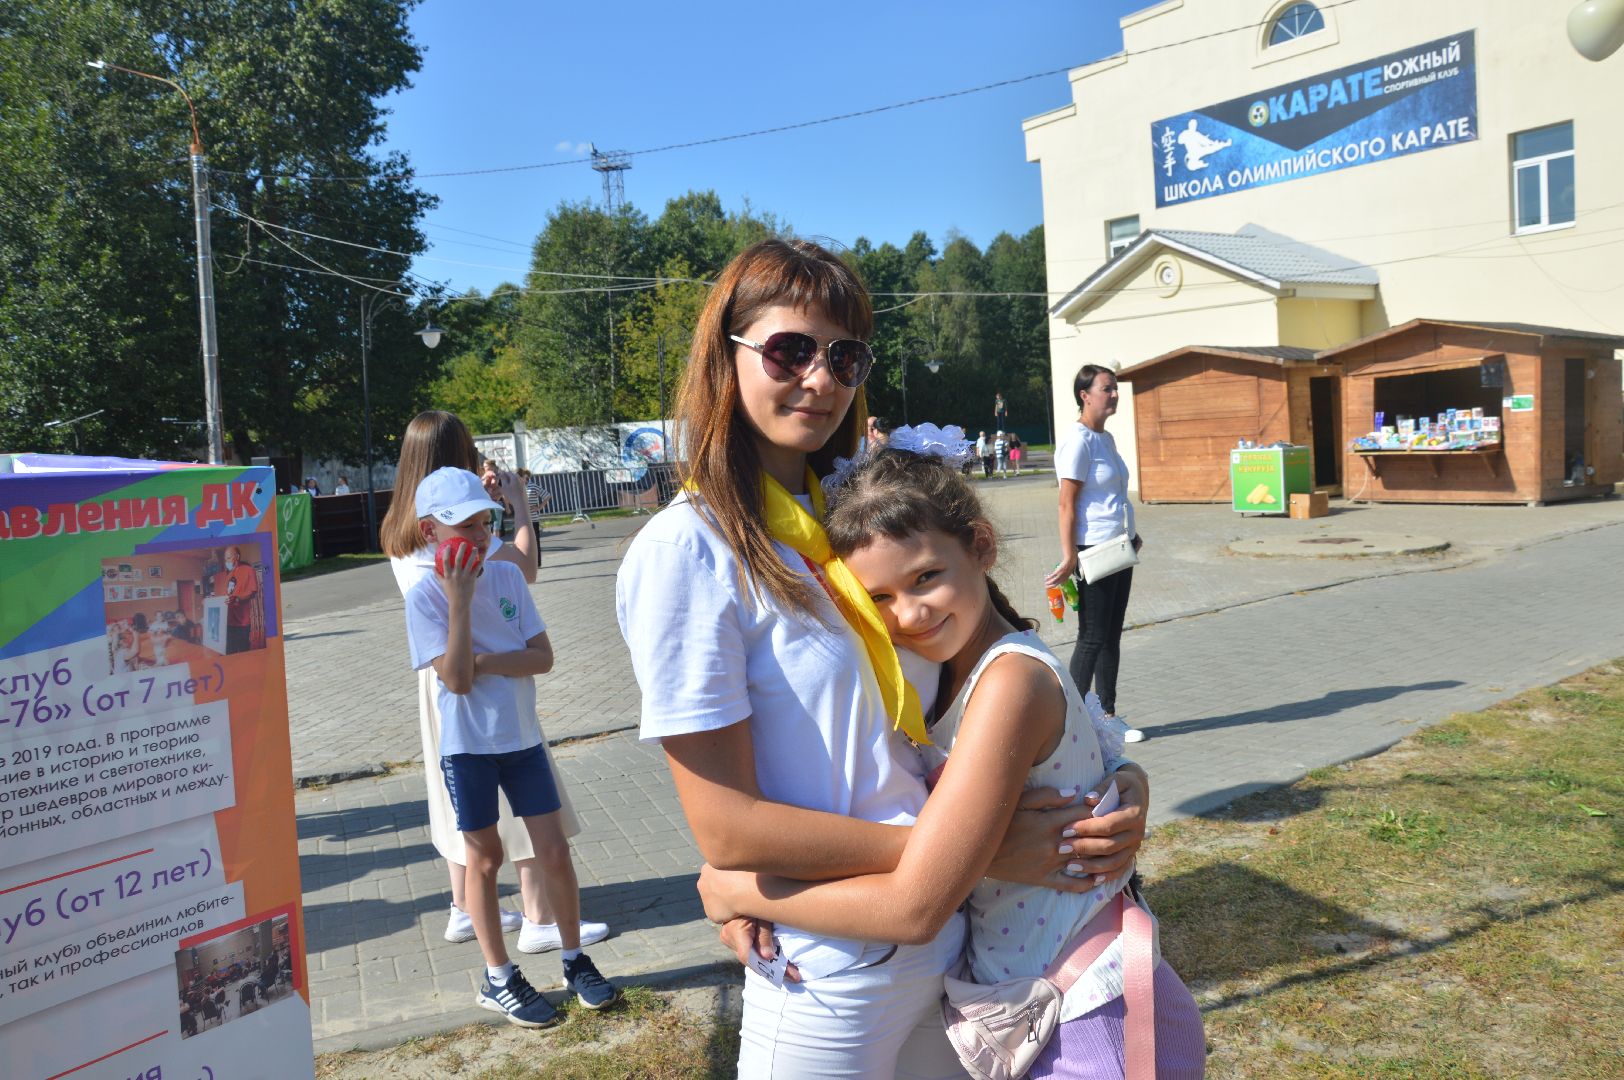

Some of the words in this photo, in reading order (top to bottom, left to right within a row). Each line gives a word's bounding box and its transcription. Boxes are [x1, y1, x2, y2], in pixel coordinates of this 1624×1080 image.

[1383, 41, 1461, 81] ЮЖНЫЙ
[1383, 72, 1436, 94] СПОРТИВНЫЙ
[1437, 66, 1460, 79] КЛУБ
[1268, 66, 1384, 124] КАРАТЕ
[1164, 175, 1224, 202] ШКОЛА
[1228, 137, 1386, 187] ОЛИМПИЙСКОГО
[1391, 117, 1469, 152] КАРАТЕ
[195, 480, 262, 529] ДК
[83, 684, 130, 717] (от
[138, 677, 155, 704] 7
[165, 662, 224, 699] лет)
[12, 745, 52, 766] 2019
[57, 738, 101, 756] года.
[106, 732, 115, 746] В
[120, 715, 211, 744] программе
[37, 767, 45, 778] в
[50, 750, 124, 775] историю
[129, 746, 138, 757] и
[142, 733, 200, 753] теорию
[0, 776, 79, 803] отехнике
[85, 773, 94, 784] и
[99, 748, 206, 780] светотехнике,
[19, 787, 108, 817] шедевров
[112, 767, 188, 795] мирового
[193, 762, 213, 775] ки-
[71, 791, 158, 820] областных
[161, 788, 171, 798] и
[175, 773, 230, 795] между-
[0, 897, 46, 944] уб
[56, 887, 105, 920] (от
[114, 870, 143, 899] 12
[152, 848, 212, 890] лет)
[9, 975, 39, 993] так
[44, 969, 54, 981] и
[60, 919, 204, 976] профессионалов
[34, 943, 81, 968] клуб»
[86, 915, 172, 950] объединил
[176, 895, 235, 921] любите-
